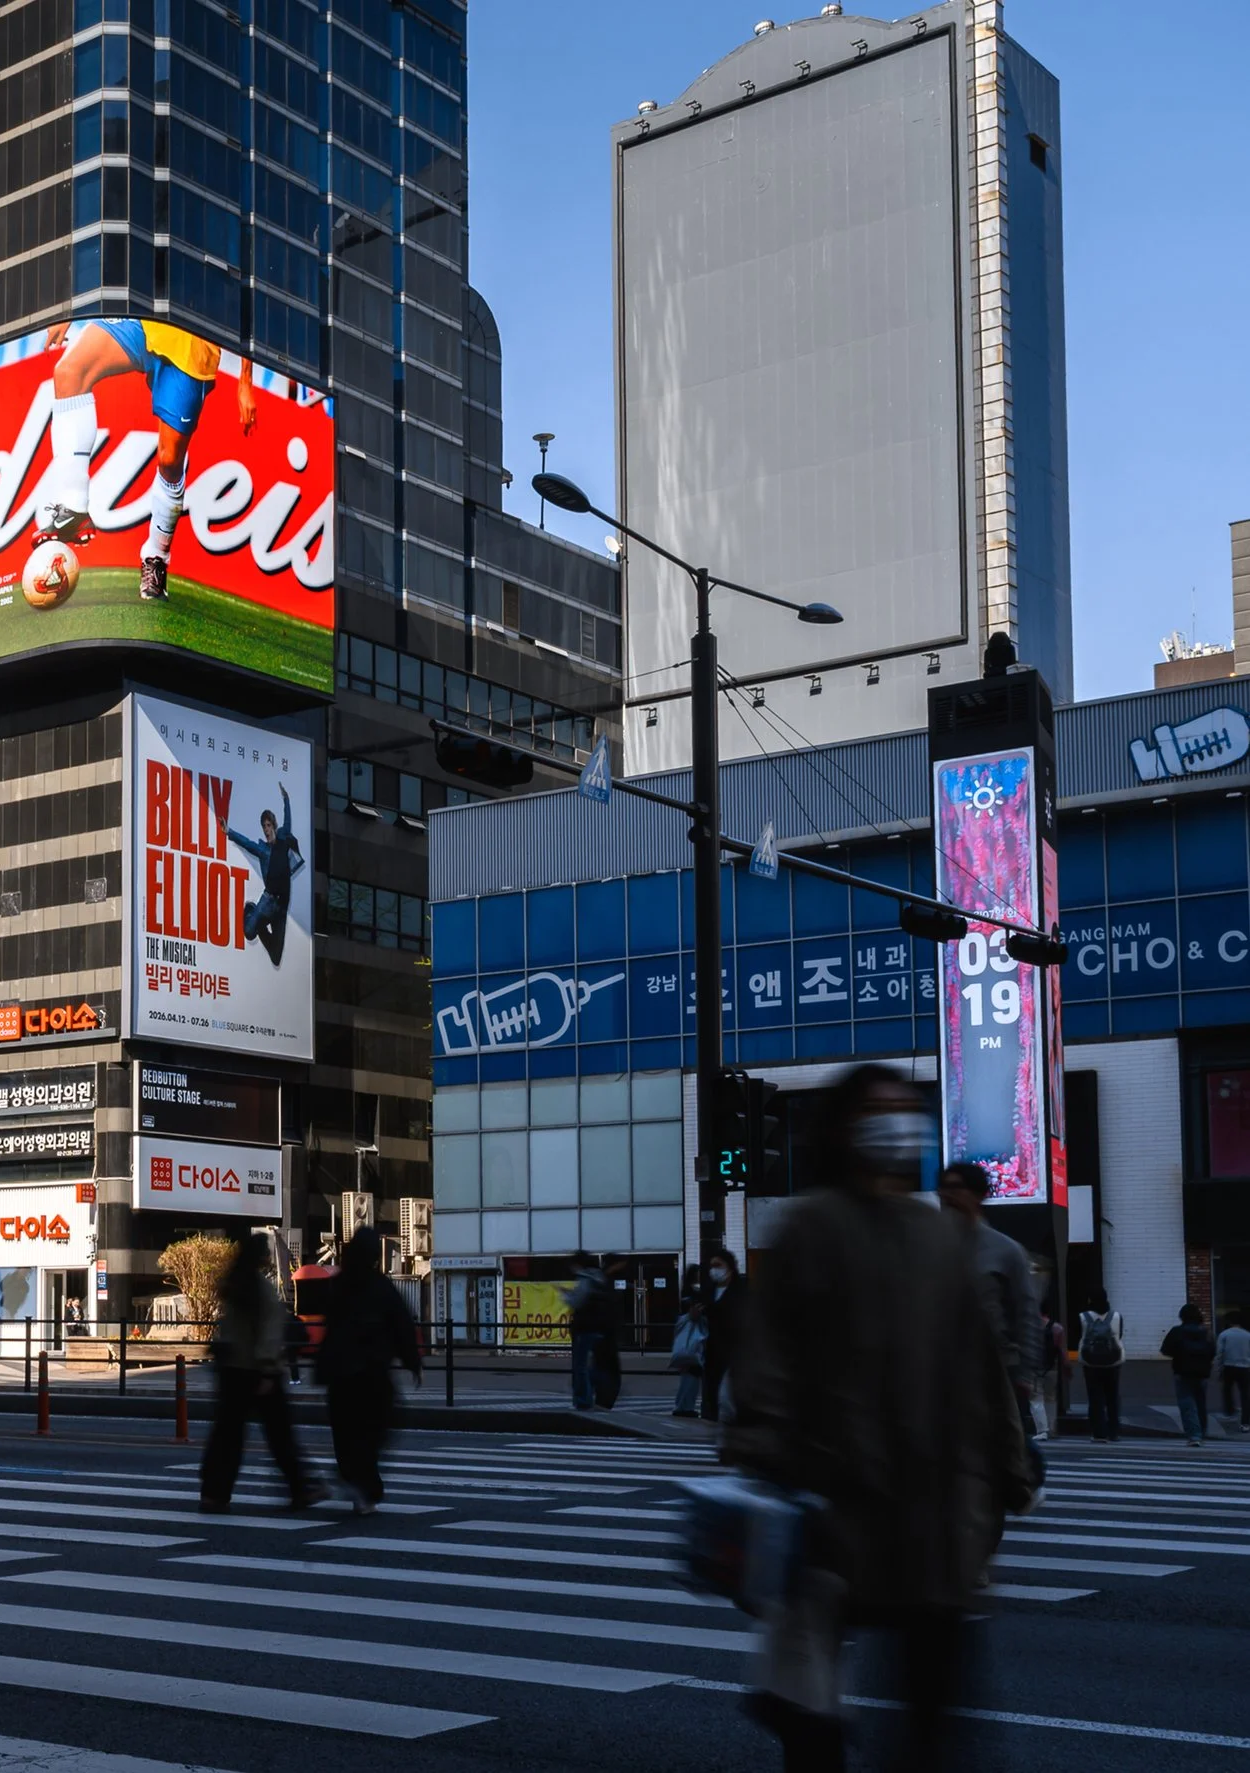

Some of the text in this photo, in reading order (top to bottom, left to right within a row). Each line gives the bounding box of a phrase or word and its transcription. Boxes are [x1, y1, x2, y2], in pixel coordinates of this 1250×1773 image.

[146, 759, 233, 861] BILLY
[146, 847, 249, 950] ELLIOT
[146, 937, 197, 966] THE MUSICAL
[958, 930, 1020, 976] 03
[1077, 937, 1175, 976] CHO
[1188, 941, 1204, 960] &
[146, 963, 231, 1000] 빌리 엘리어트
[646, 974, 677, 993] 강남
[961, 980, 1021, 1026] 19
[25, 1003, 98, 1033] 다이소
[149, 1011, 186, 1024] 2026.04.12
[191, 1017, 209, 1028] 07.26
[980, 1036, 1002, 1049] PM
[142, 1069, 187, 1087] REDBUTTON
[142, 1085, 201, 1105] CULTURE STAGE
[153, 1178, 170, 1188] daiso
[178, 1165, 240, 1193] 다이소
[0, 1214, 70, 1240] 다이소
